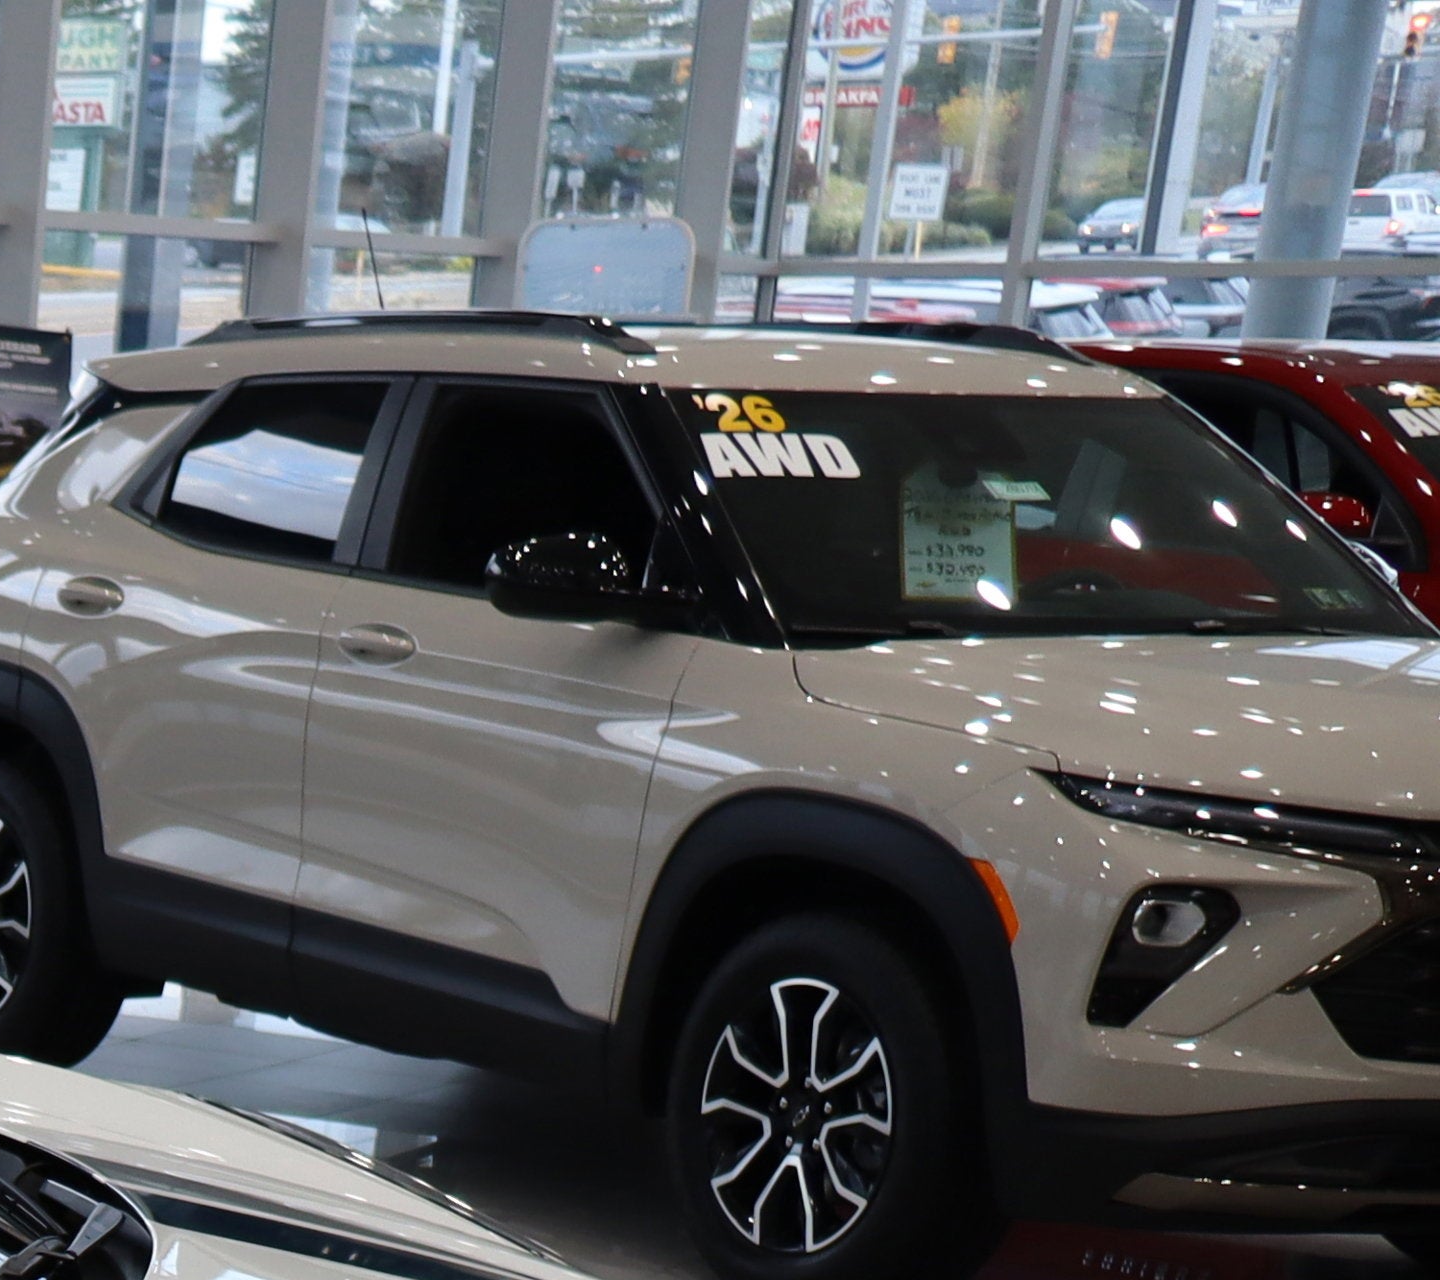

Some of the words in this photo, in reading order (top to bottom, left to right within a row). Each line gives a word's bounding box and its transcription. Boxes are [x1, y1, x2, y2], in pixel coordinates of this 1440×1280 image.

[59, 54, 116, 69] PANY
[803, 90, 880, 106] BRAKFA
[52, 101, 107, 124] ASTA
[692, 394, 786, 433] '26
[700, 432, 861, 480] AWD
